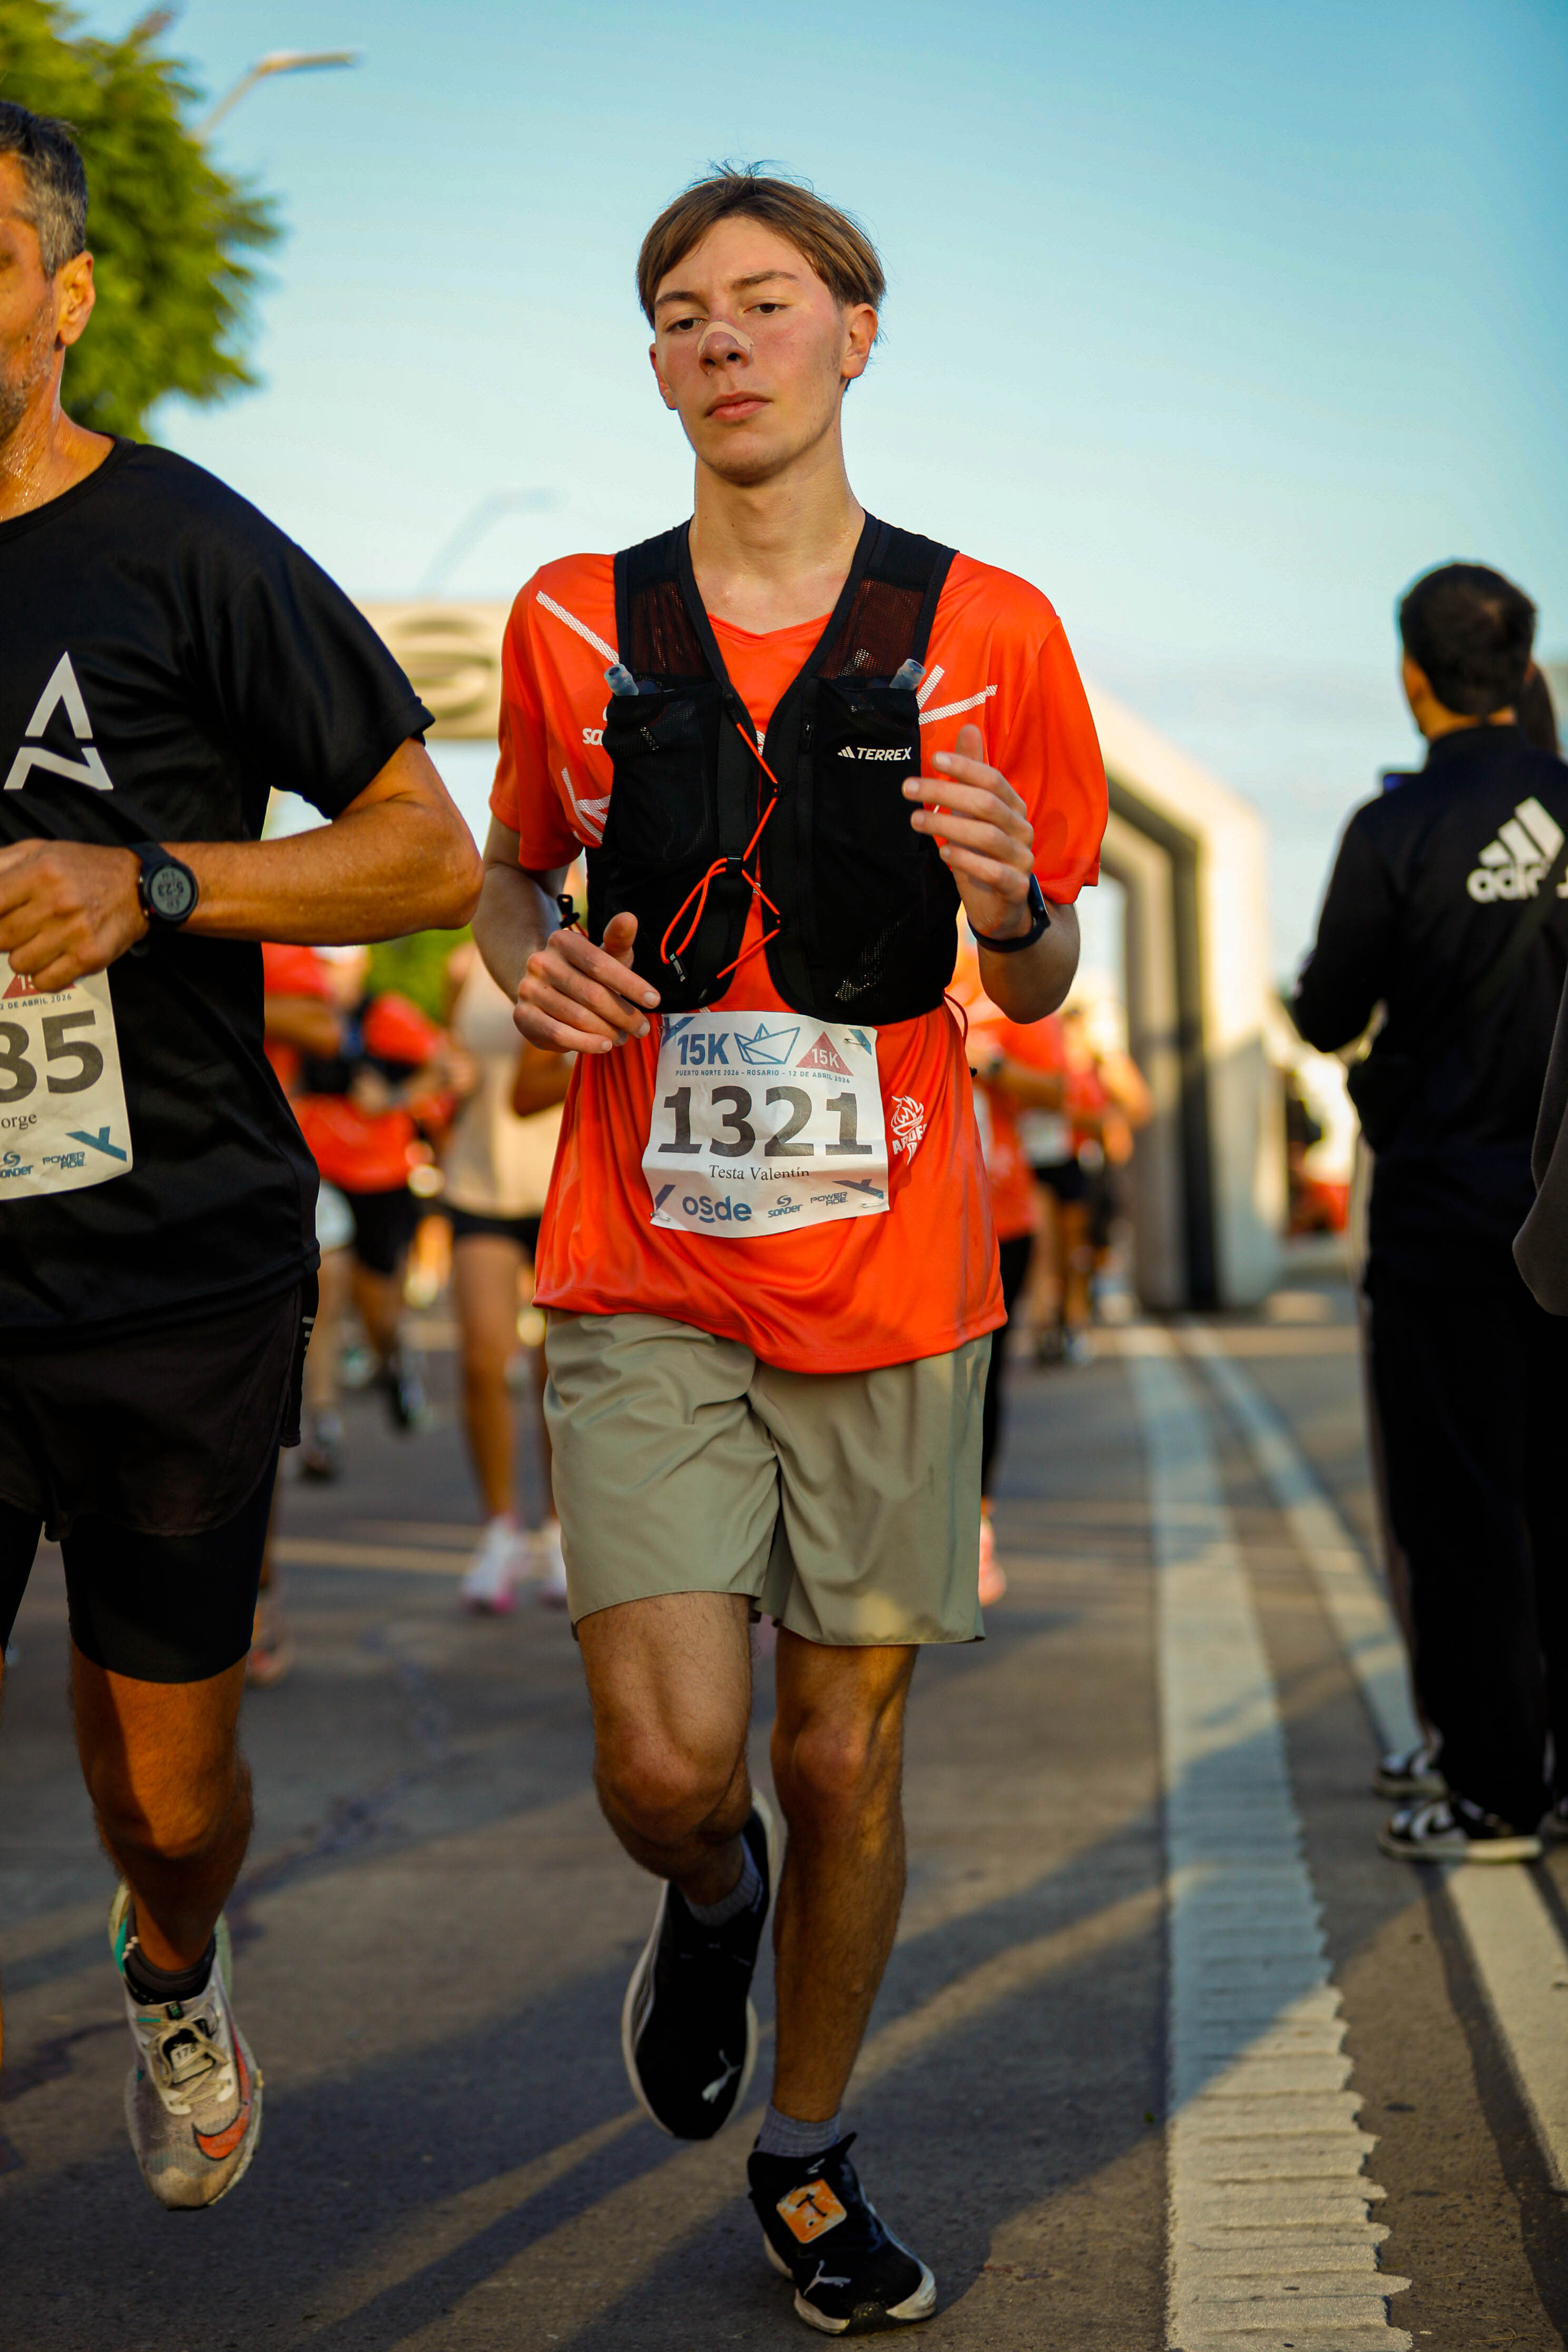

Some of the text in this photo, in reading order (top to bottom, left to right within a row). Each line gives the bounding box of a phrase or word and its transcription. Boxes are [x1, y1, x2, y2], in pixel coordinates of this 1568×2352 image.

[857, 747, 912, 761] TERREX
[22, 997, 48, 1007] ABRIL
[677, 1033, 730, 1065] 15K
[811, 1048, 839, 1069] 15K
[812, 1072, 832, 1080] ABRIL
[658, 1085, 873, 1158] 1321
[42, 1151, 85, 1165] POWER
[709, 1164, 809, 1181] Testa Valentín
[810, 1192, 847, 1203] POWER
[682, 1195, 752, 1222] osde
